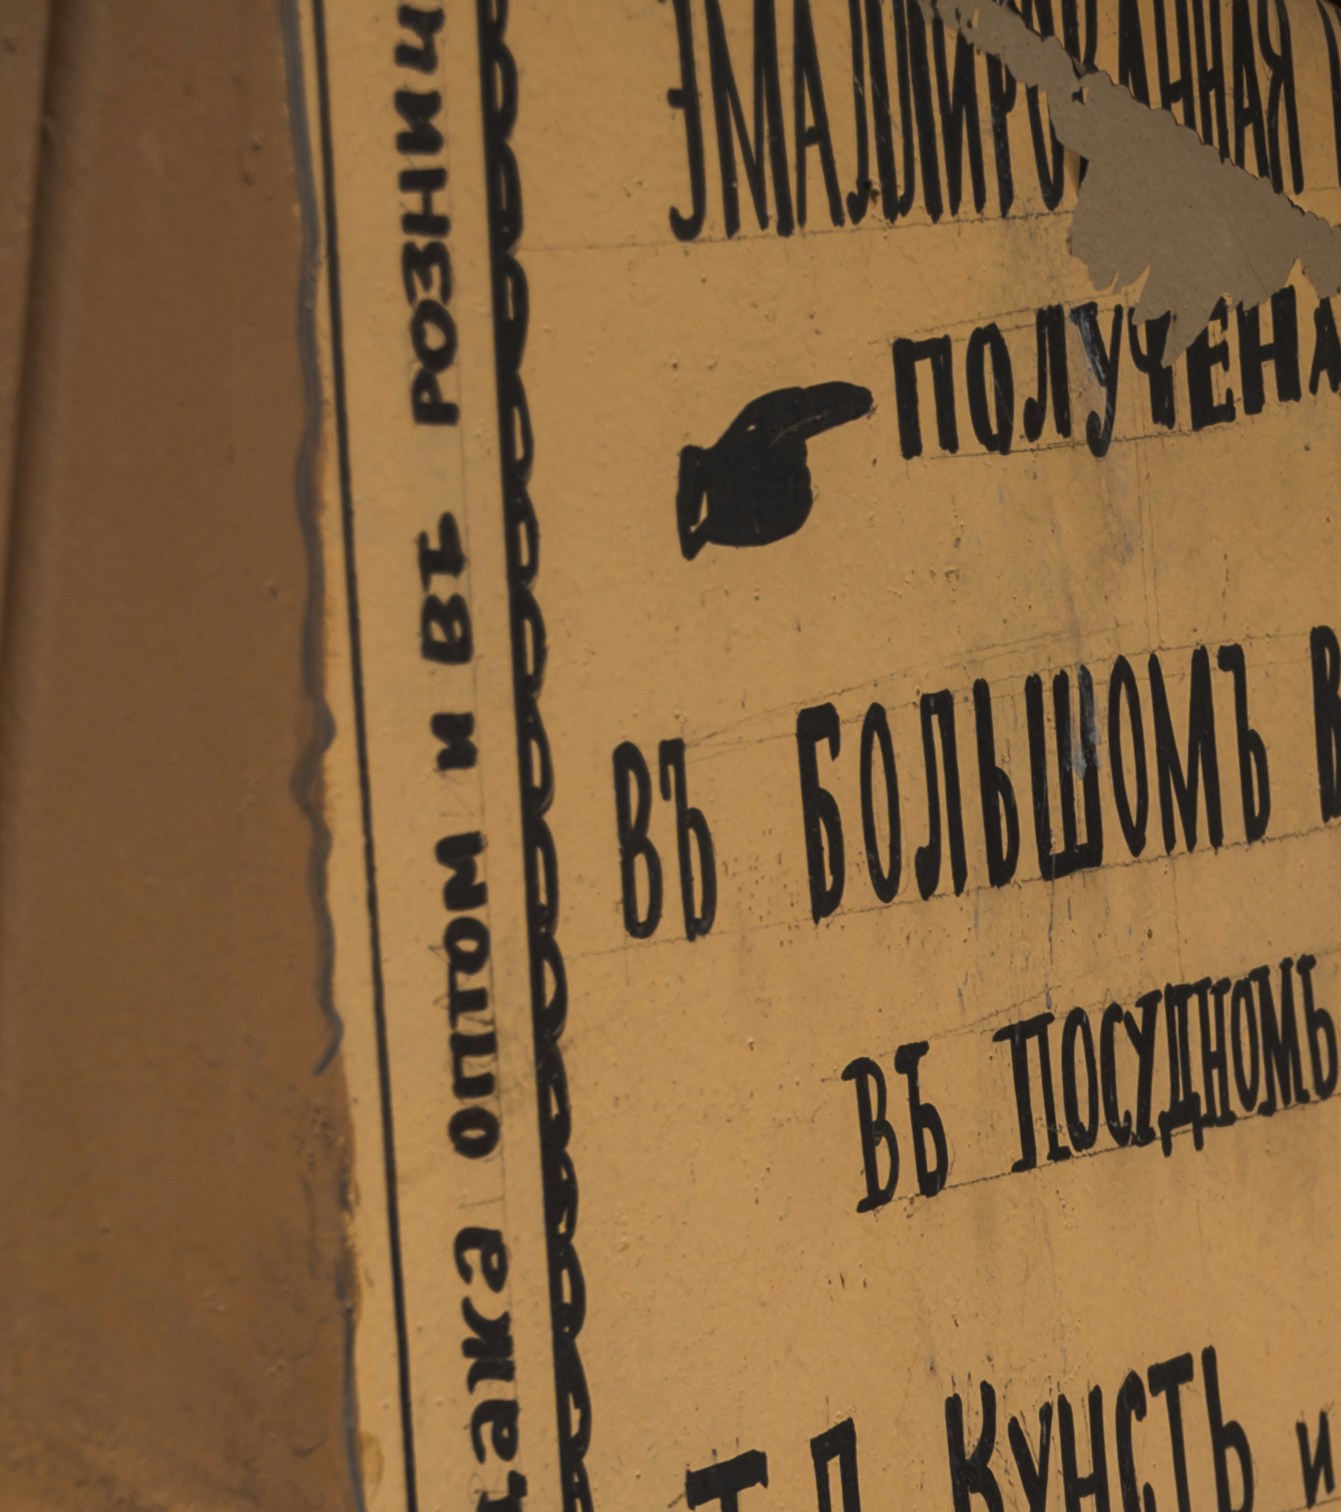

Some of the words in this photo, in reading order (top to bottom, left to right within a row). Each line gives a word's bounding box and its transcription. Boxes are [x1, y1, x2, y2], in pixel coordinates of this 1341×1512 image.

[612, 738, 719, 942] ВЪ
[797, 643, 1272, 925] БОЛЬШОМЪ
[434, 831, 499, 1160] ОПТОМ
[841, 1040, 950, 1213] ВЪ
